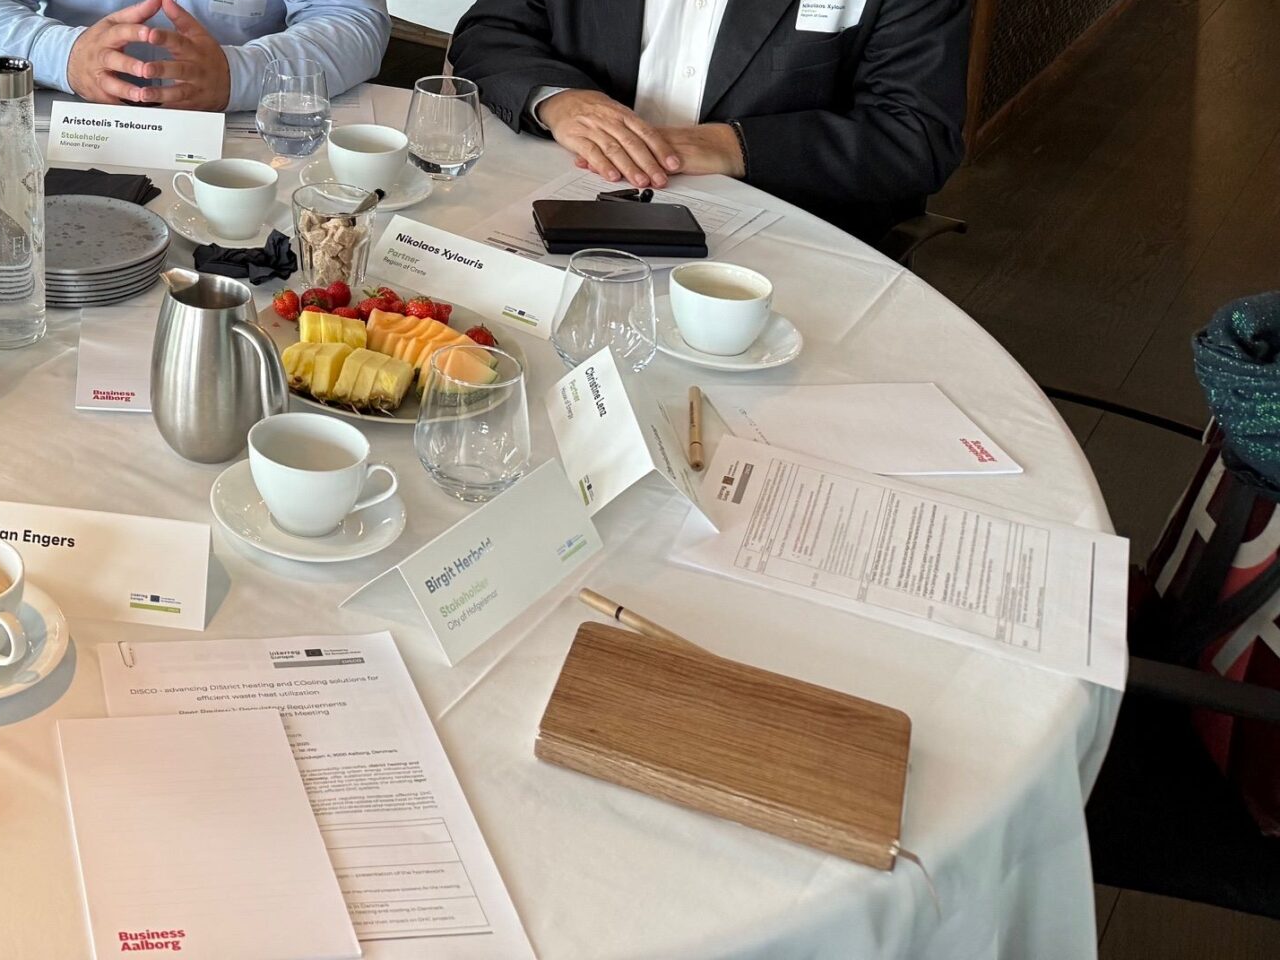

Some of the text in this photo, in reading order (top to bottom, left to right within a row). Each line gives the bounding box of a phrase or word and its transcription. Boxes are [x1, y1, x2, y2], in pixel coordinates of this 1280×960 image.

[62, 116, 163, 132] Aristotelis Tsekouras
[61, 131, 109, 142] Stakeholder
[387, 247, 420, 264] Partner
[395, 232, 484, 270] Nikolaos Xylouris
[585, 366, 607, 418] Christine Lenz
[23, 530, 75, 548] Engers
[424, 566, 457, 595] Birgit
[439, 577, 490, 618] Stakeholder
[447, 617, 462, 632] City
[466, 590, 498, 618] Hofgeismar
[130, 687, 158, 695] DISCO
[164, 684, 208, 695] advancing
[242, 681, 275, 691] heating
[275, 680, 293, 688] and
[328, 676, 367, 685] solutions
[367, 674, 379, 682] for
[196, 688, 320, 702] efficient waste heat utilization
[286, 700, 347, 712] Requirements
[294, 709, 330, 718] Meeting
[118, 929, 186, 951] Business Aalborg
